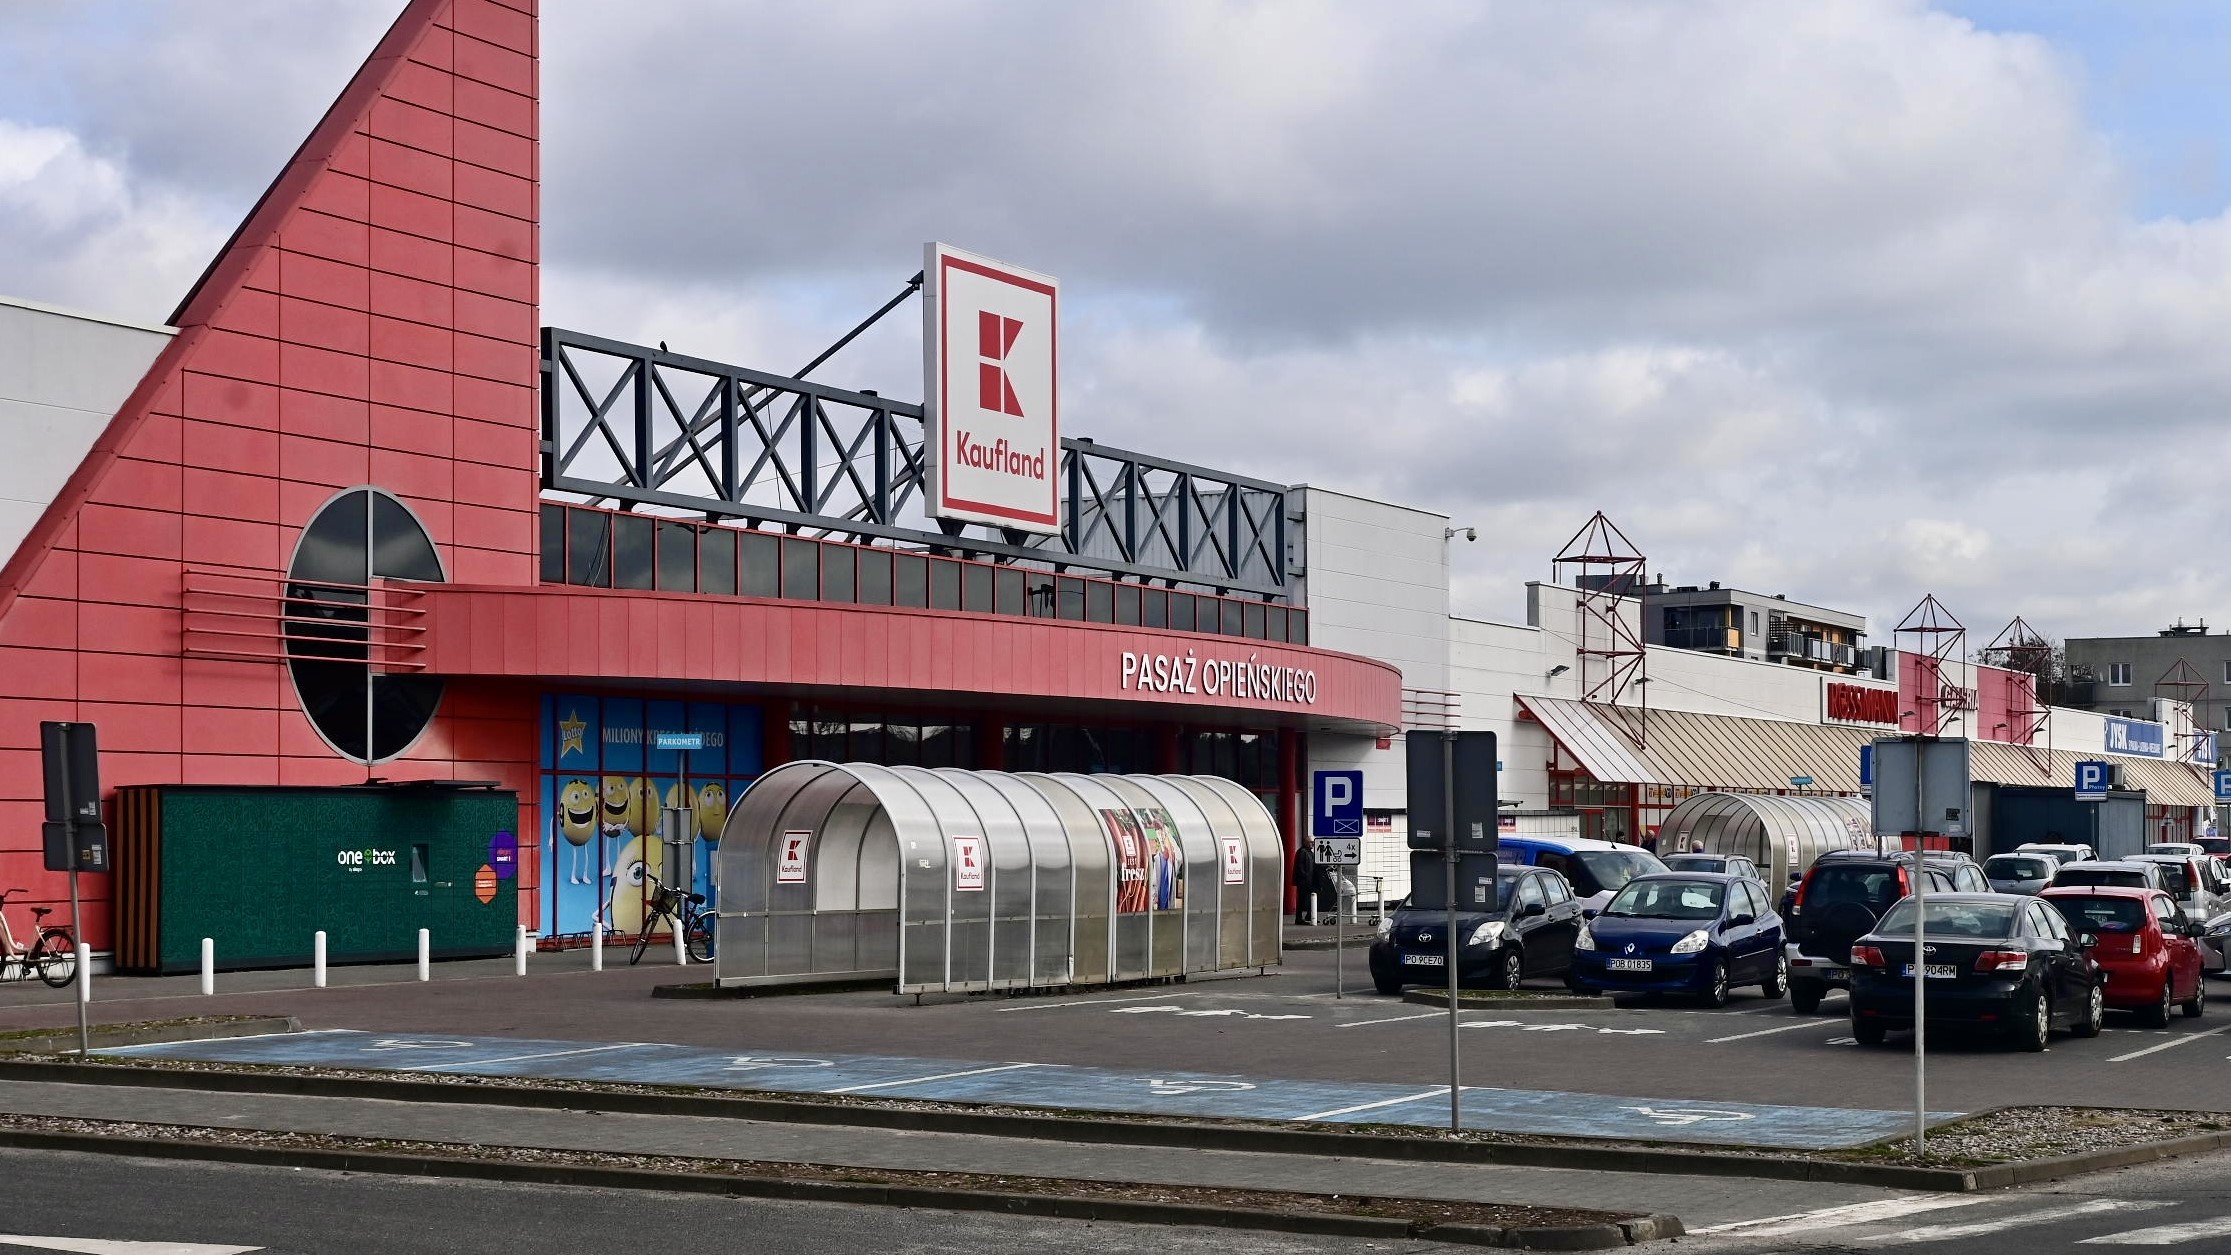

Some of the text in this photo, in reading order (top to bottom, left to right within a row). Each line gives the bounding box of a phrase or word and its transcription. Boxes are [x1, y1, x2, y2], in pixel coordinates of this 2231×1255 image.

[956, 430, 1044, 480] Kaufland
[1121, 648, 1317, 704] PASAŻ OPIEŃSKIEGO
[561, 727, 585, 741] Lotto
[602, 727, 644, 744] MILIONY
[658, 738, 701, 746] PARKOMETR
[2110, 722, 2127, 750] JYSK
[2083, 766, 2100, 789] P
[1325, 777, 1352, 817] P
[1346, 843, 1356, 851] 4x
[1611, 960, 1651, 968] POB 01835
[1925, 965, 1955, 976] 904RM
